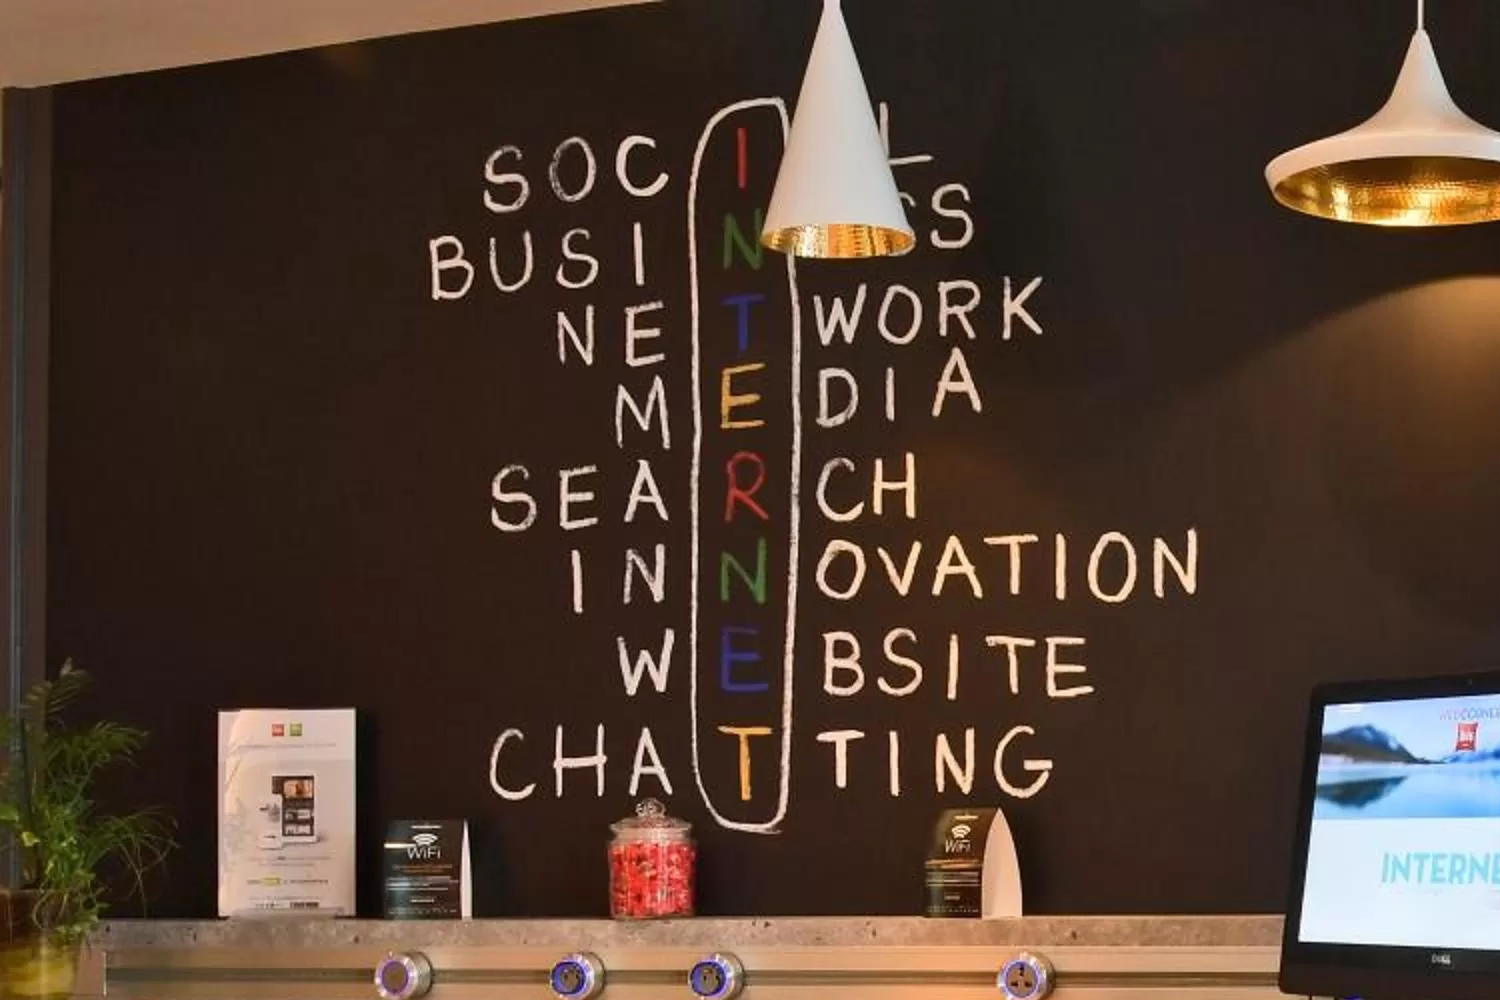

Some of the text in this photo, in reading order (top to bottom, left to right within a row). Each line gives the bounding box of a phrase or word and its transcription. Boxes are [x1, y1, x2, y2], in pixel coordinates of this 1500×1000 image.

[483, 101, 934, 213] SOCIL
[428, 184, 974, 301] BUSINS
[407, 846, 441, 860] WiFi
